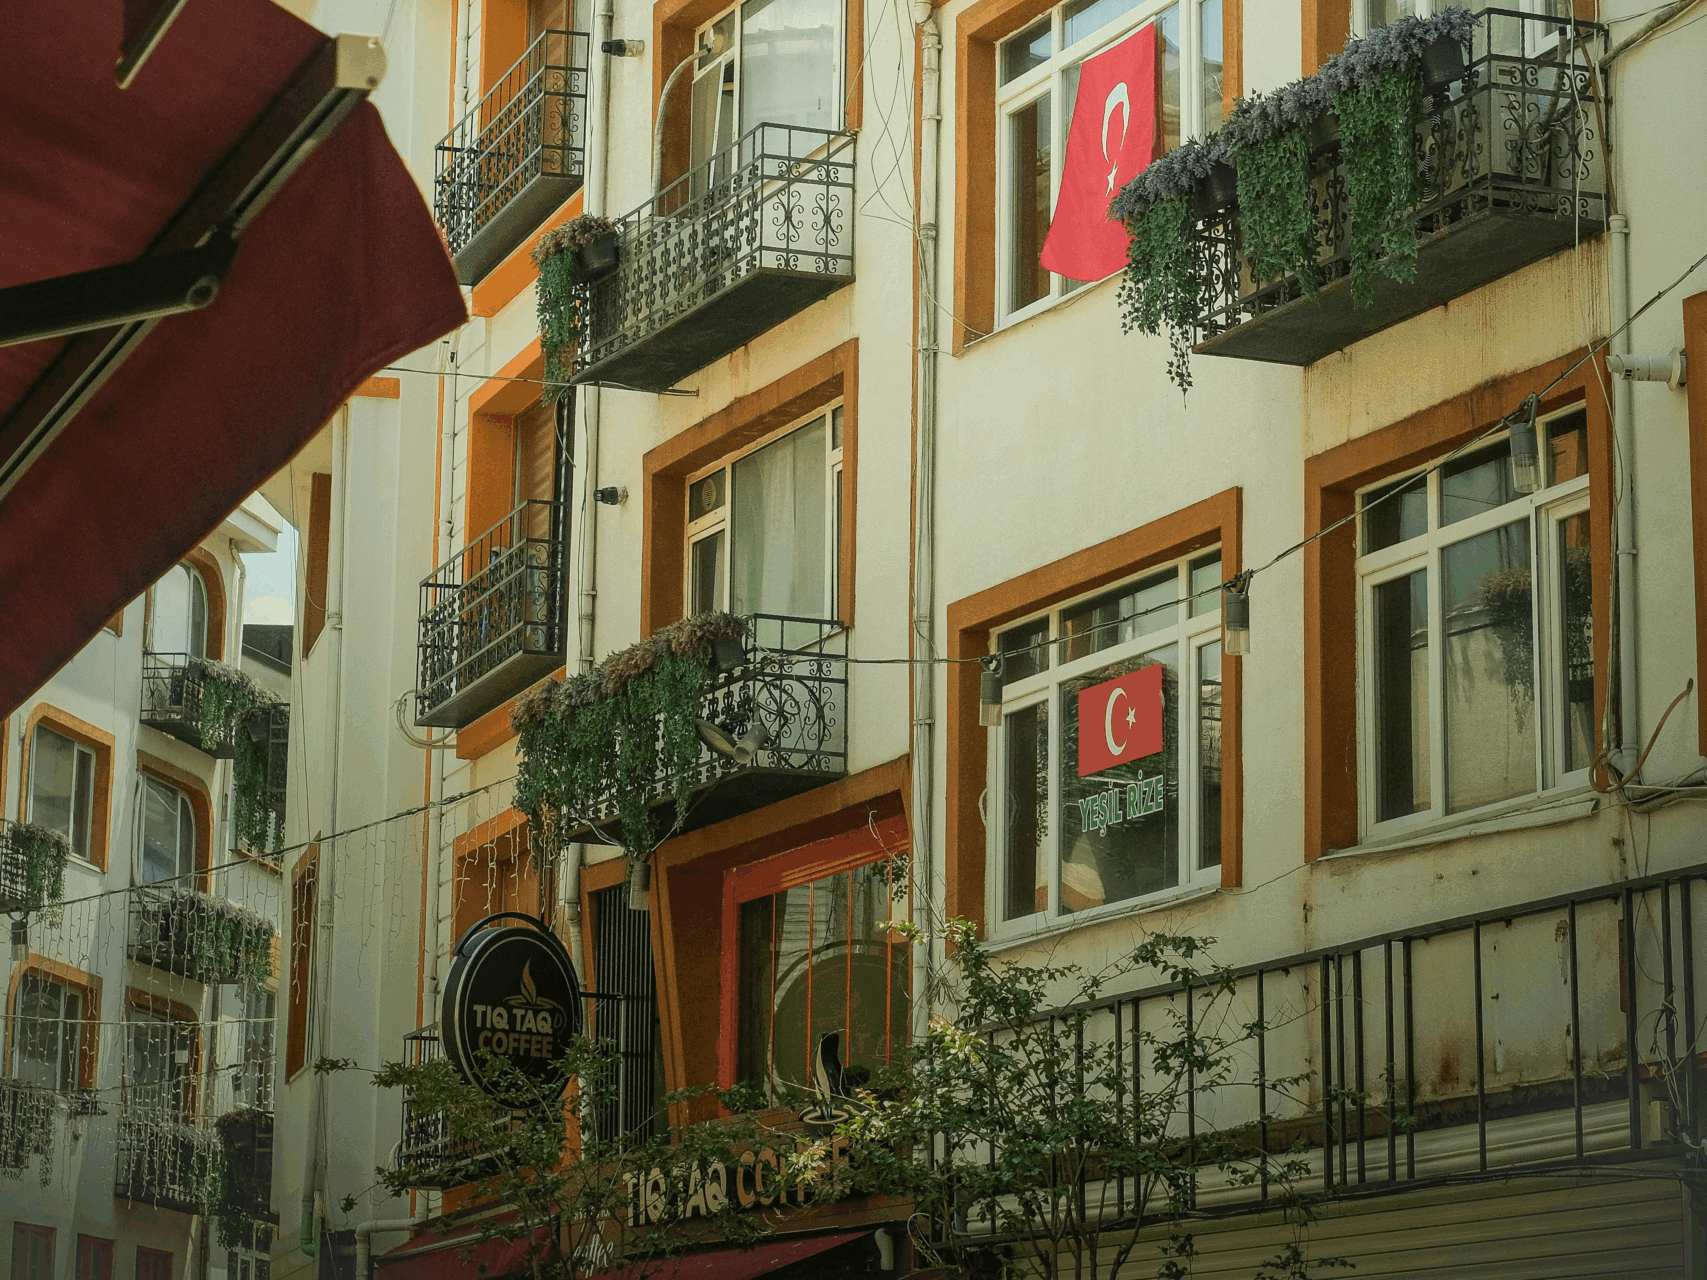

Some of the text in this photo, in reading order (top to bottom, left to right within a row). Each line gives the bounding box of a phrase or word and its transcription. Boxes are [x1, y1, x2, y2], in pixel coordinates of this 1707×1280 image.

[1078, 769, 1164, 837] YEŞİL RİZE
[473, 1004, 553, 1034] TIQ TAQ
[478, 1030, 553, 1059] COFFEE
[623, 1167, 667, 1227] TIQ
